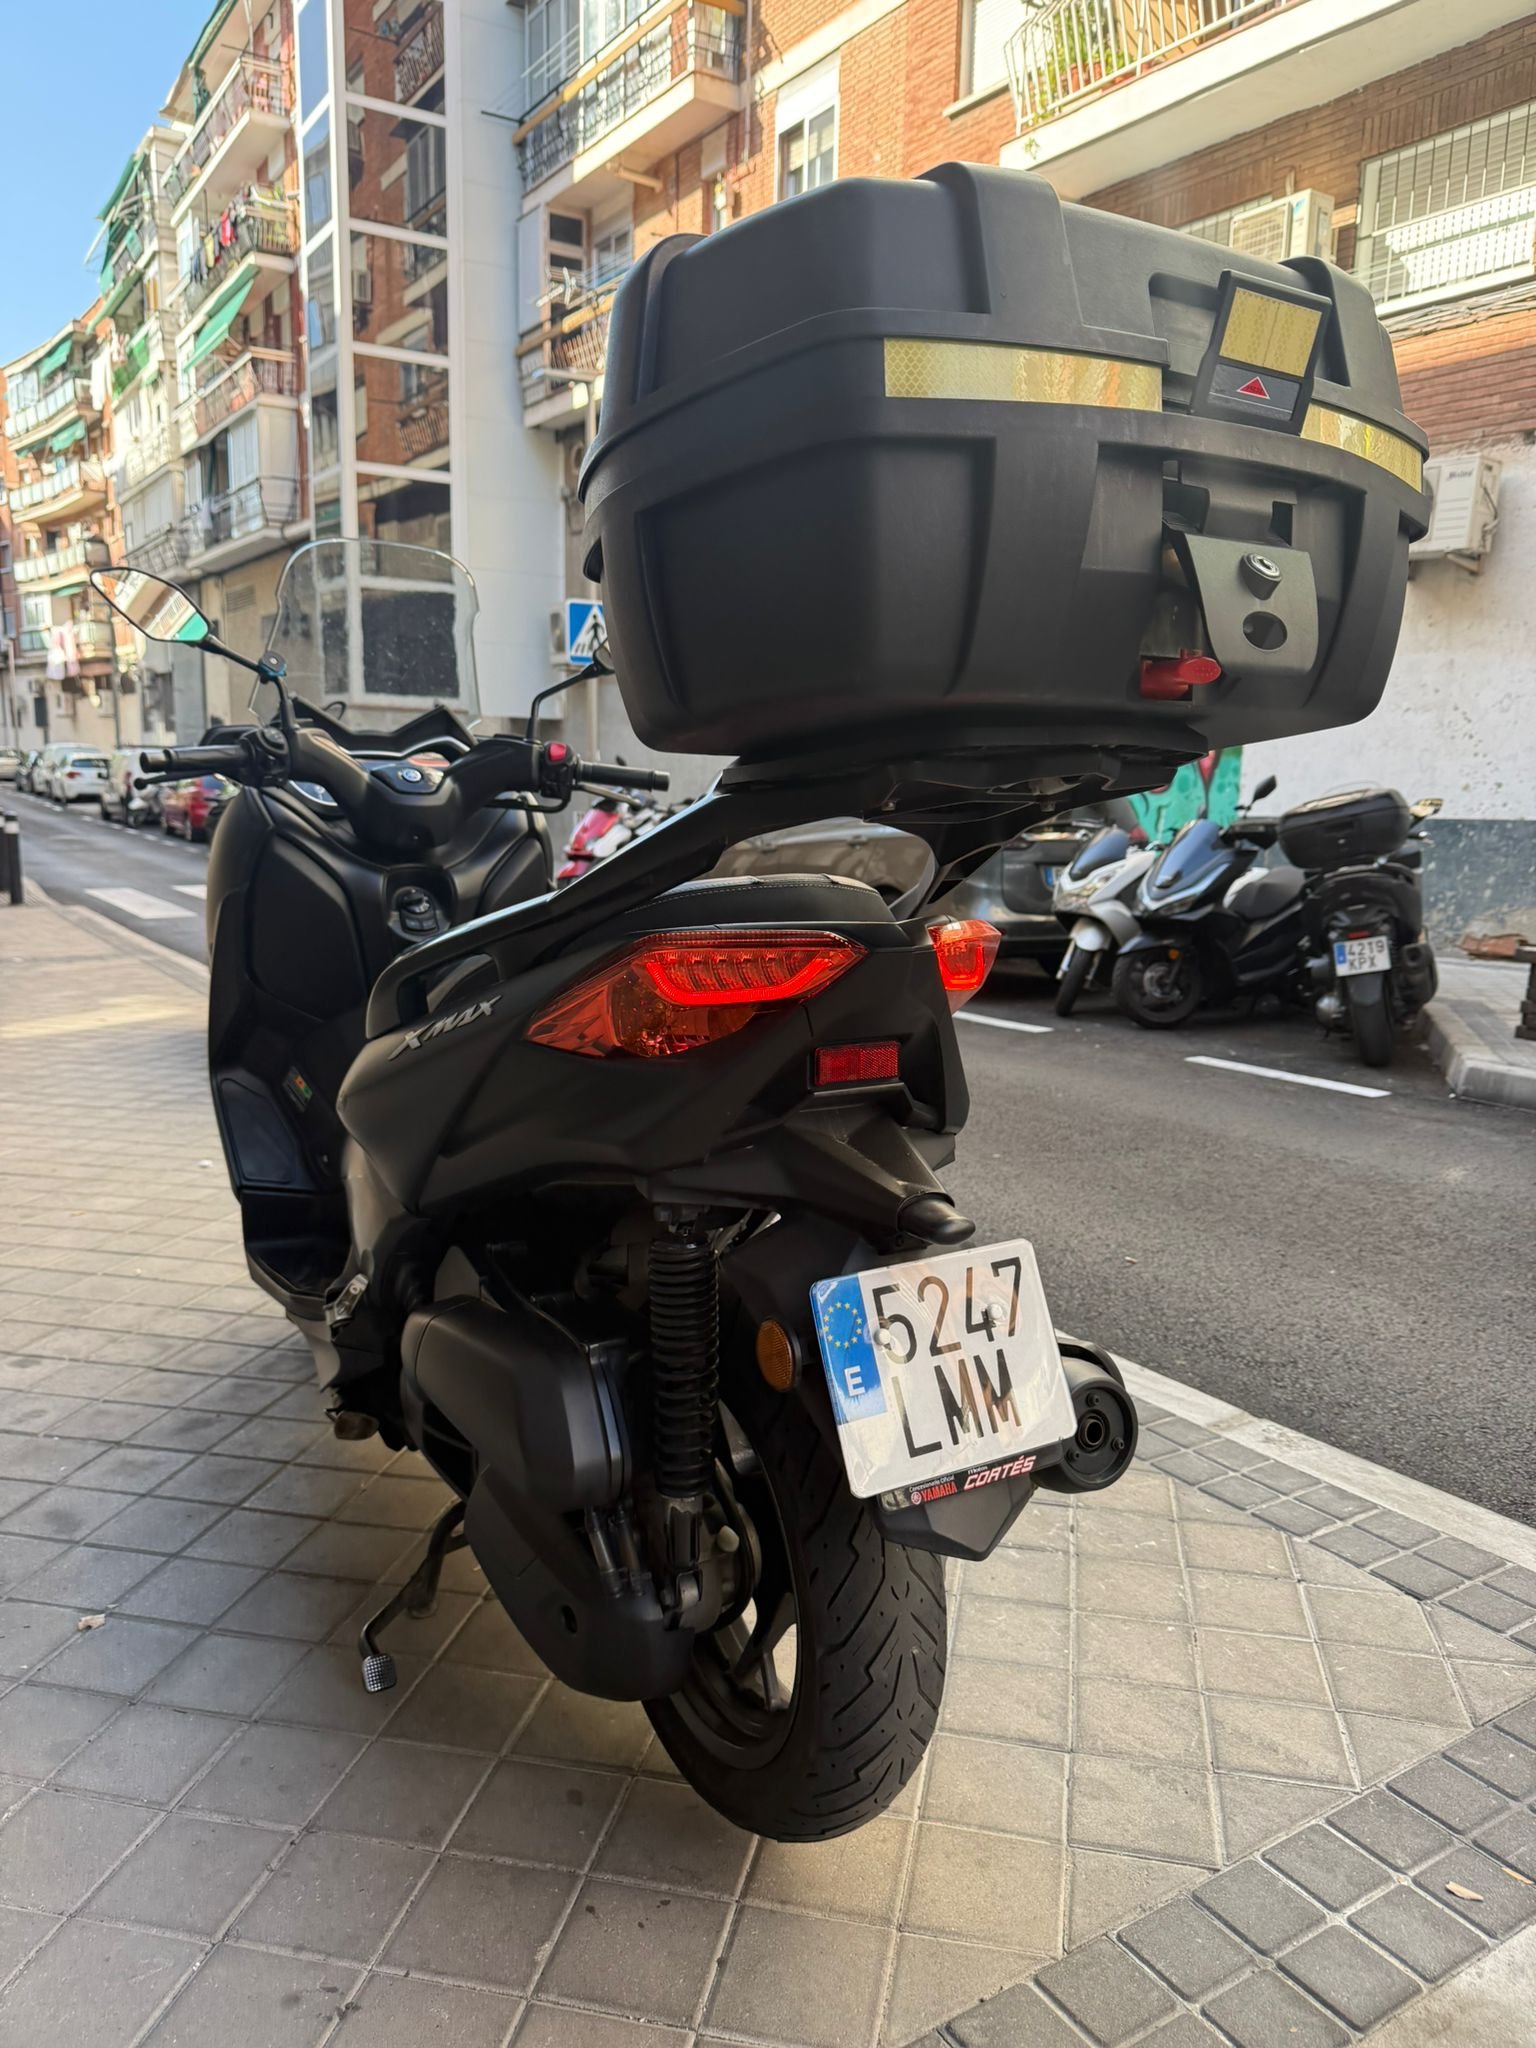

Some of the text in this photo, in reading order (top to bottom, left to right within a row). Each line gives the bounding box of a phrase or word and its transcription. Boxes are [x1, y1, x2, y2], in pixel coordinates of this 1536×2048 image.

[1348, 955, 1377, 971] KPX
[388, 995, 502, 1060] XMAX
[872, 1256, 1022, 1365] 5247
[844, 1365, 866, 1397] E
[891, 1348, 1022, 1458] LMM
[963, 1455, 1037, 1491] CORTÉS
[920, 1481, 957, 1502] YAMAHA
